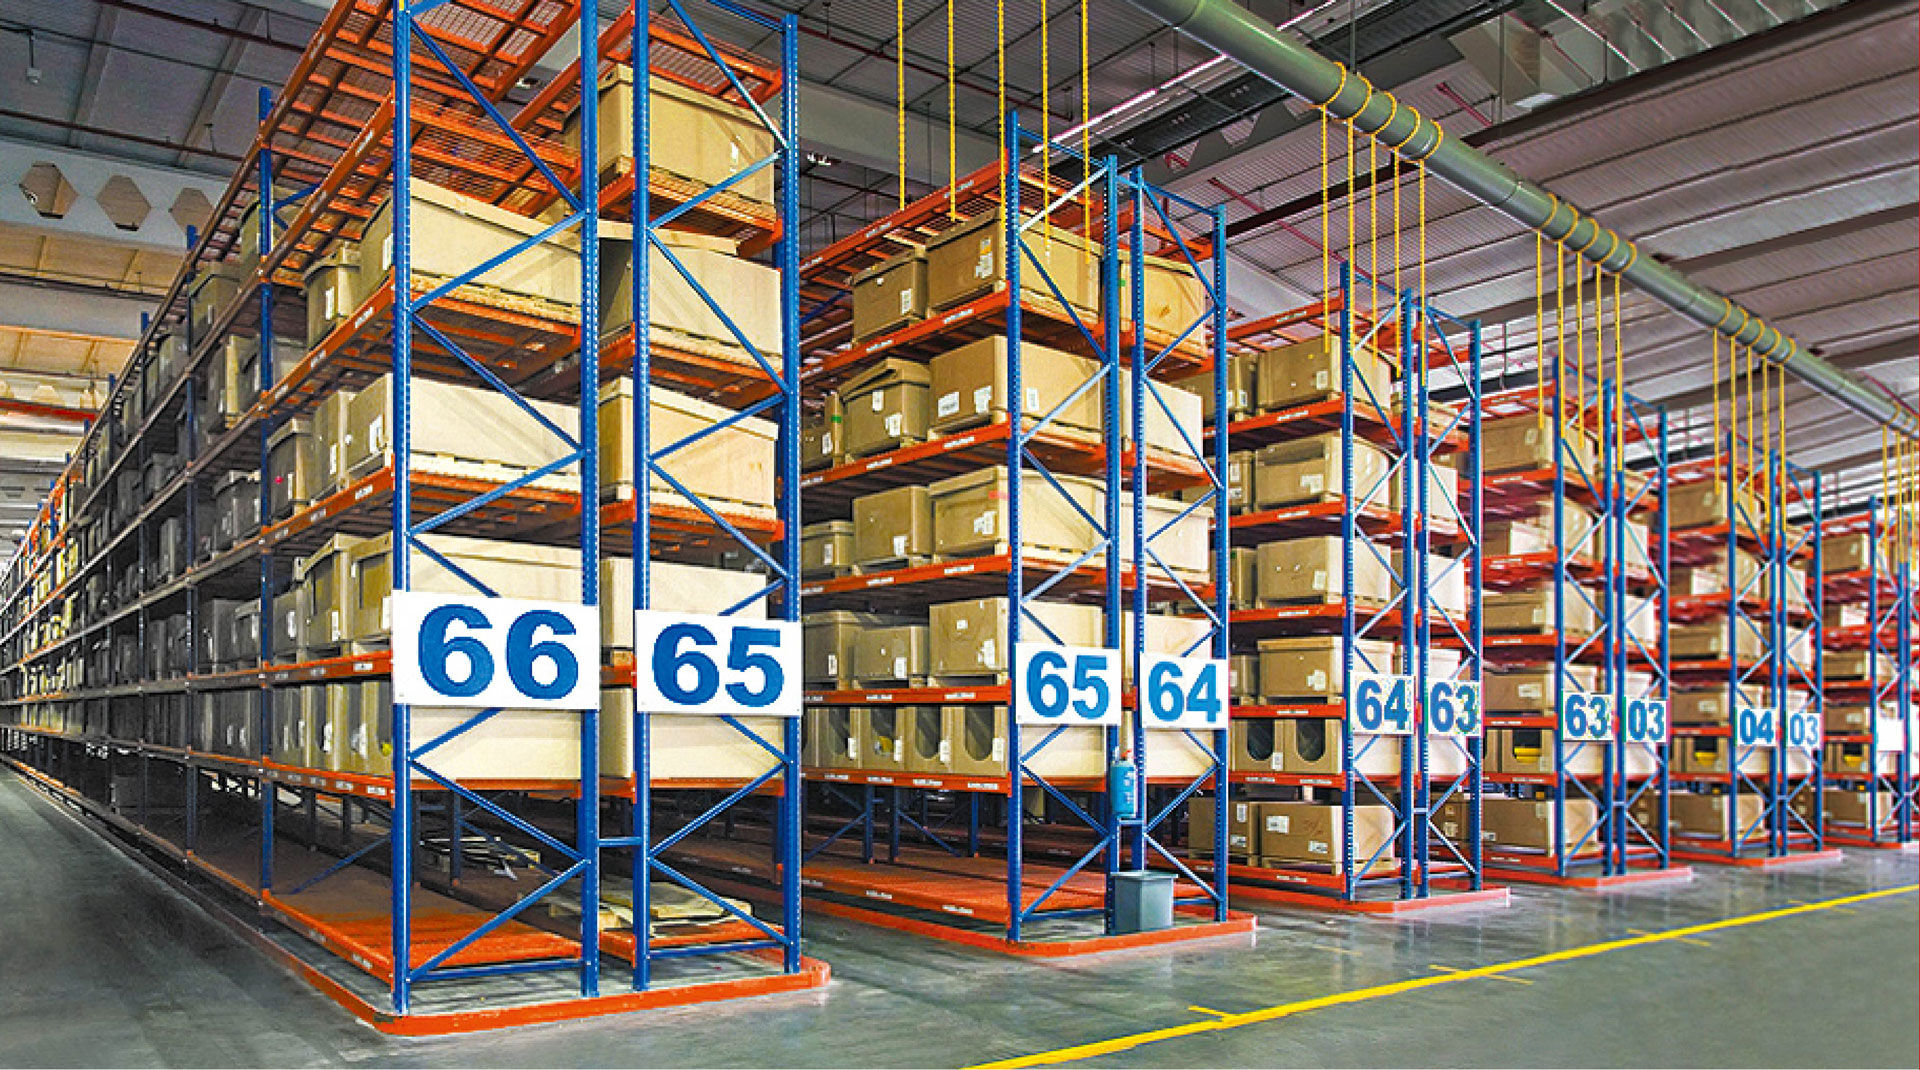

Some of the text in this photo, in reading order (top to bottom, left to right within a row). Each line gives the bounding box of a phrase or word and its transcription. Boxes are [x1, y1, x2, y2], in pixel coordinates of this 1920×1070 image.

[417, 603, 579, 701] 66
[652, 621, 785, 707] 65
[1026, 650, 1111, 721] 65
[1147, 660, 1222, 724] 64
[1356, 679, 1409, 731] 64
[1430, 681, 1478, 733] 63
[1565, 694, 1608, 738] 63
[1628, 699, 1666, 742] 03
[1739, 708, 1775, 746] 04
[1789, 712, 1820, 747] 03
